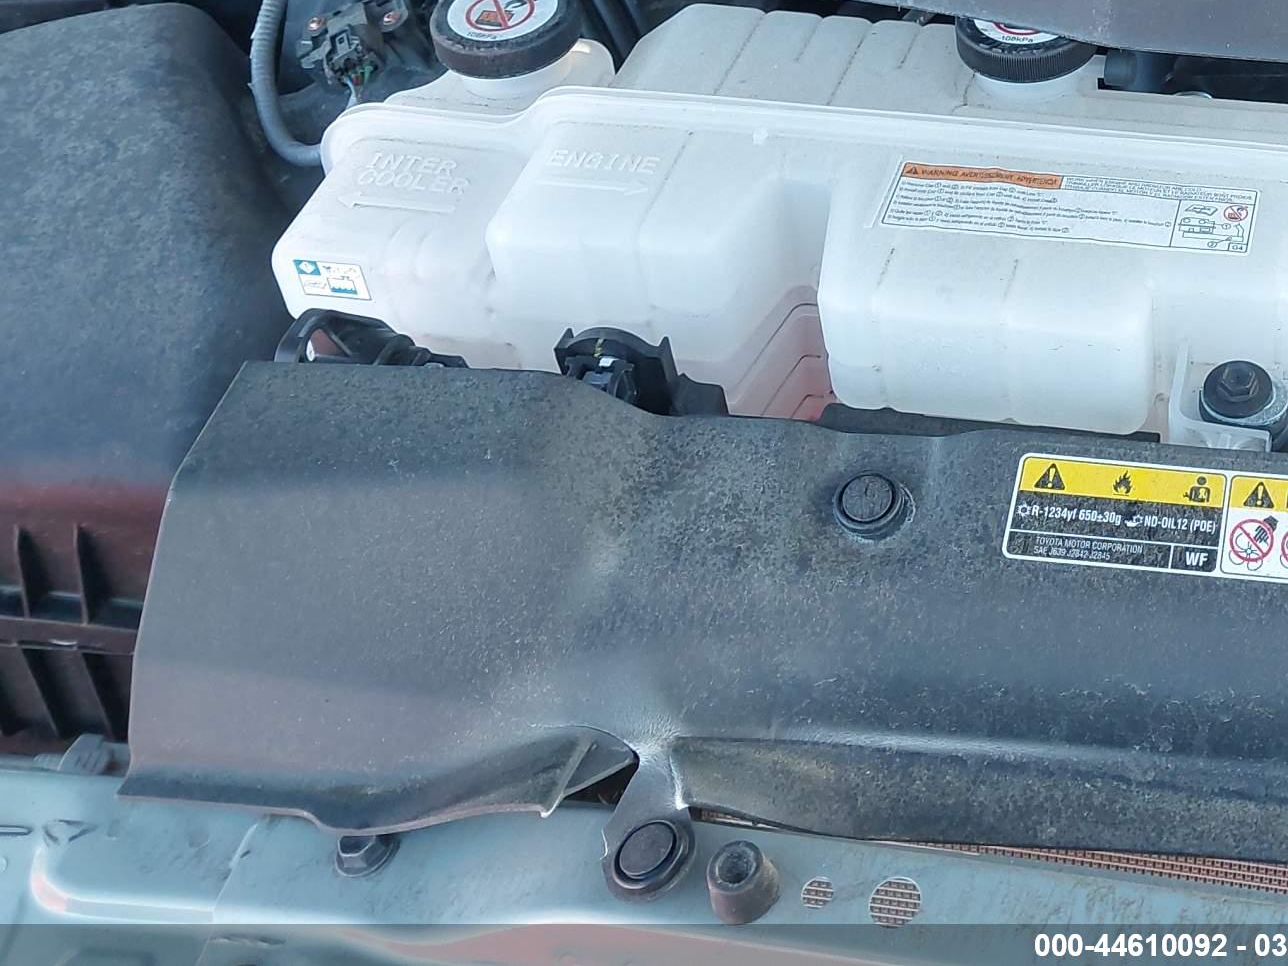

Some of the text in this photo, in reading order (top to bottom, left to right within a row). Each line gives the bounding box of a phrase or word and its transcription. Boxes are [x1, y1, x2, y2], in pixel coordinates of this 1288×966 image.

[364, 151, 459, 176] INTER
[546, 149, 661, 176] ENGINE
[356, 169, 470, 195] COOLER
[1031, 506, 1077, 522] R-1234yf
[1078, 510, 1122, 526] 650±30g
[1189, 521, 1217, 534] (POE)
[1035, 537, 1143, 554] TOYOTA MOTOR CORPORATION
[1185, 550, 1208, 567] WF
